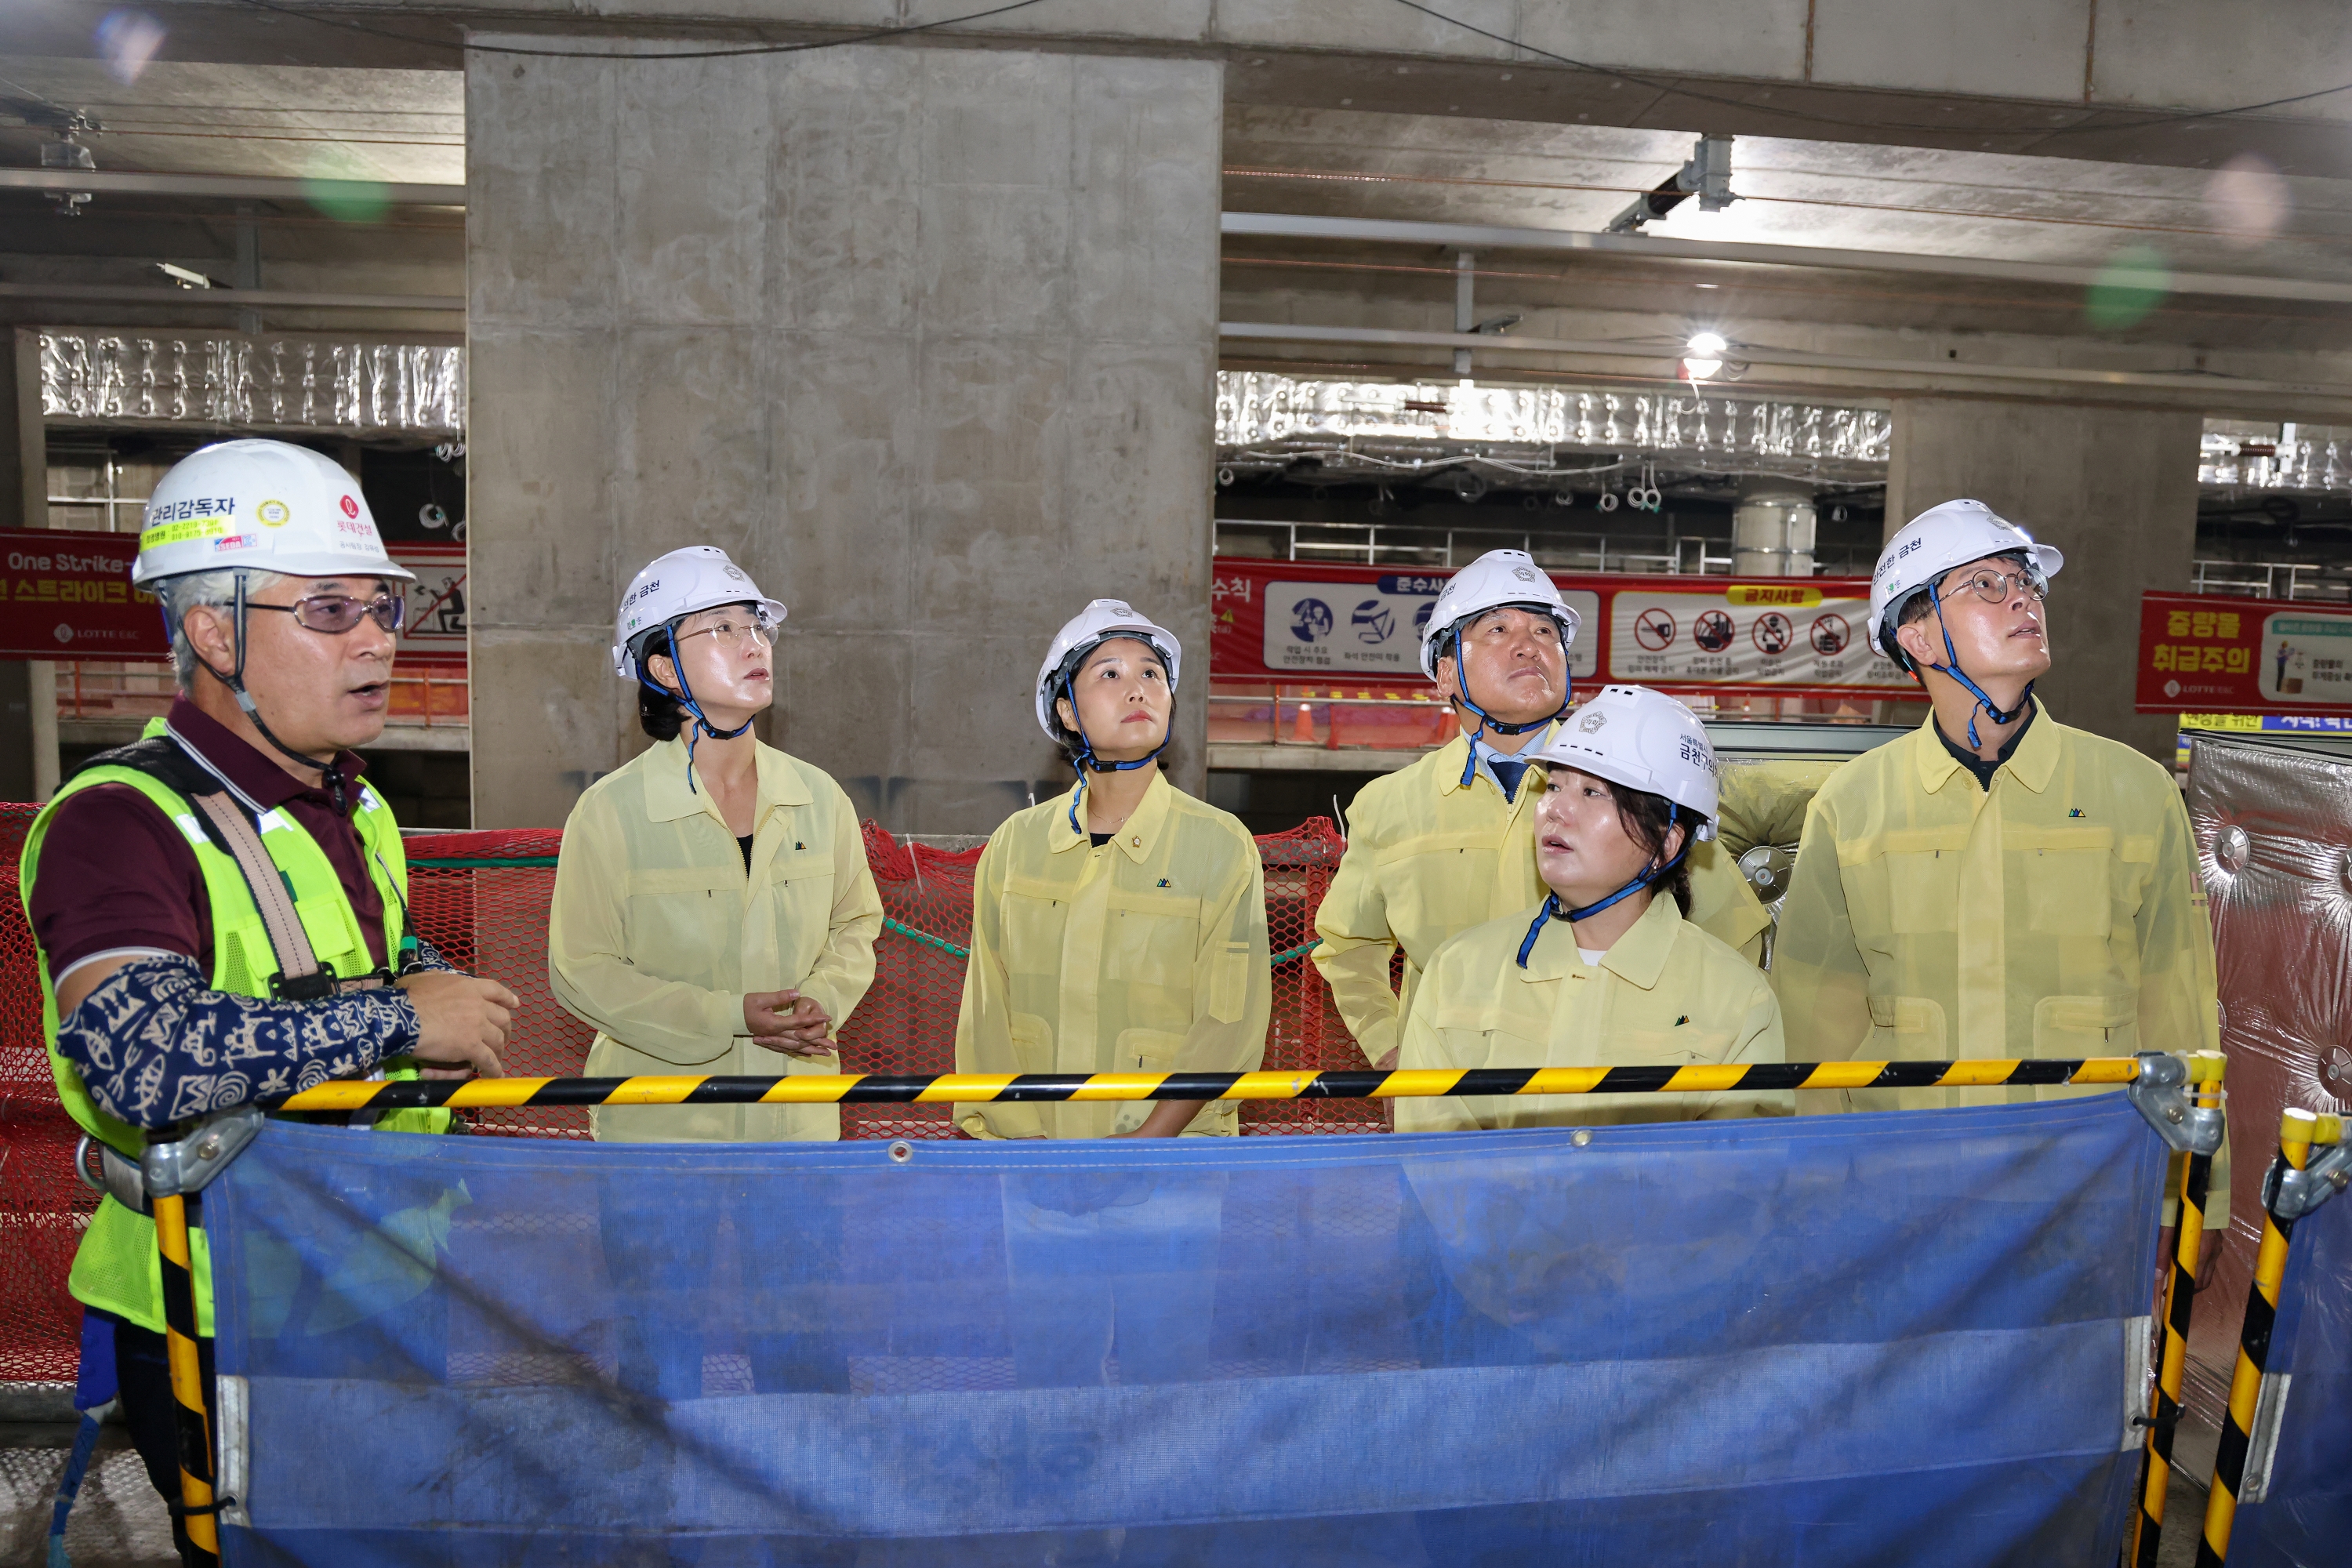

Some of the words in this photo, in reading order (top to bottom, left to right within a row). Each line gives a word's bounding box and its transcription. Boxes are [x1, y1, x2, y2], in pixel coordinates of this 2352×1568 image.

[151, 497, 235, 527] 관리감독자
[337, 520, 372, 536] 롯데건설
[1898, 537, 1922, 560] 금천
[8, 552, 51, 570] One
[15, 579, 128, 604] 스트라이크
[640, 579, 660, 598] 금천
[1396, 576, 1447, 593] 준수사
[1744, 588, 1806, 604] 금지사항
[2167, 610, 2241, 639] 중량물
[78, 630, 116, 640] LOTTE
[2153, 644, 2251, 674] 취급주의
[1679, 733, 1708, 754] 서울특별시
